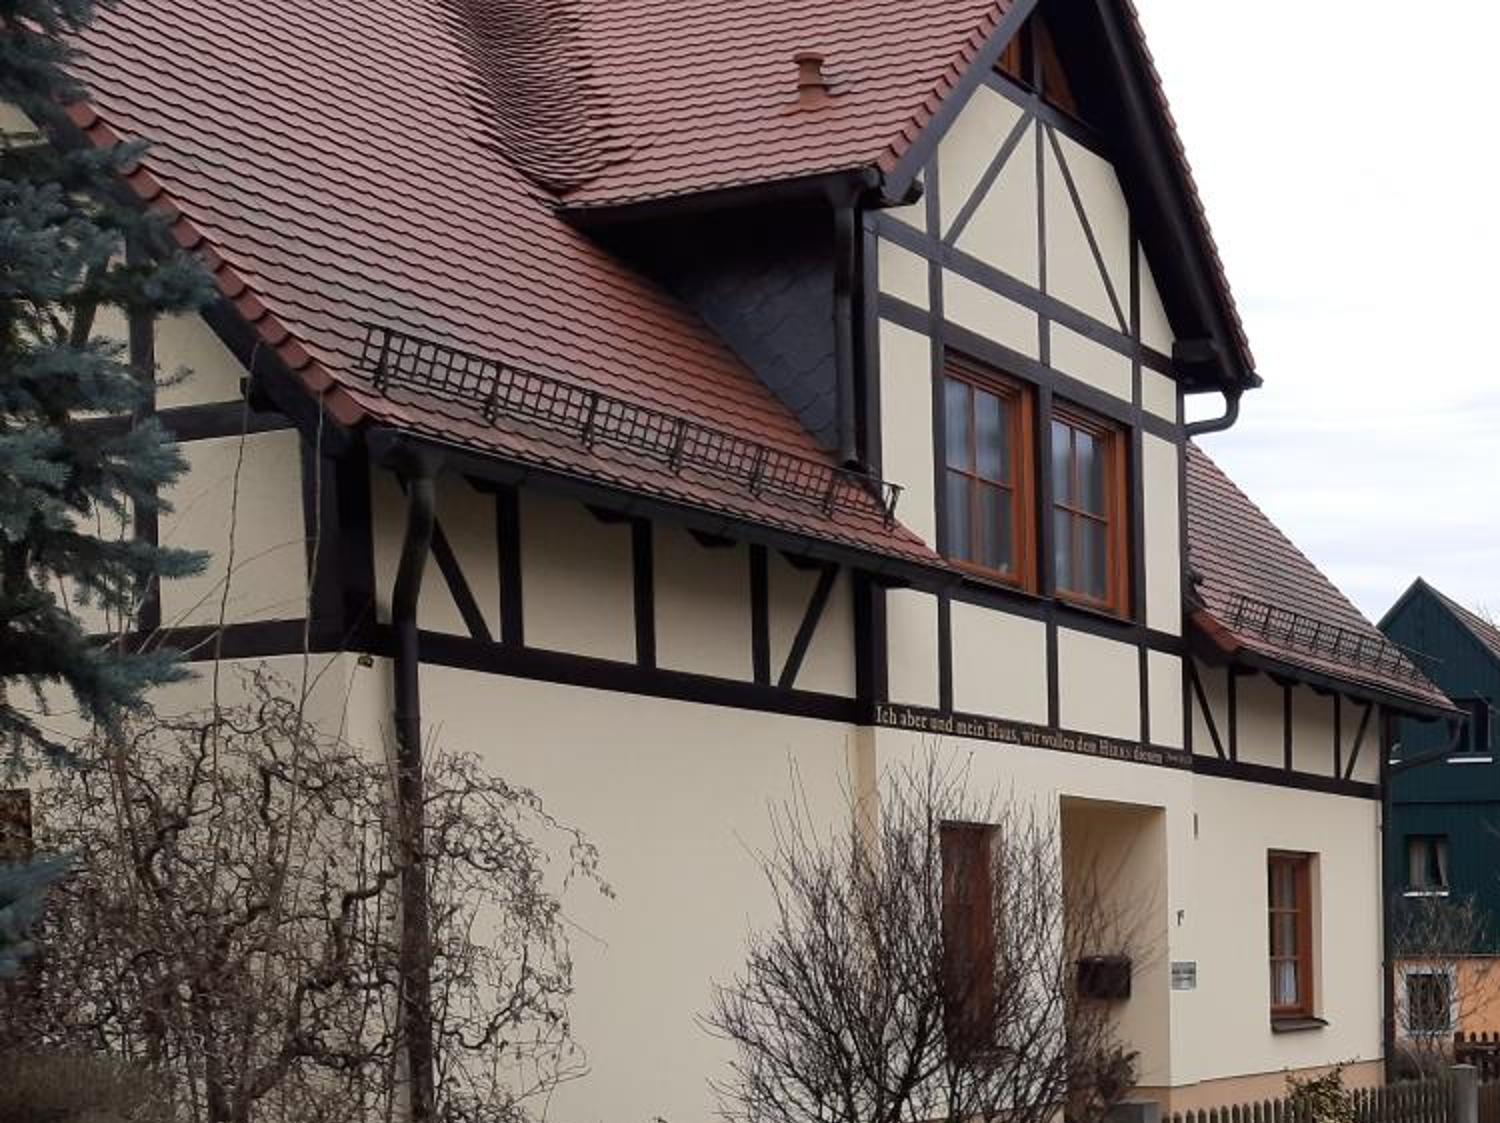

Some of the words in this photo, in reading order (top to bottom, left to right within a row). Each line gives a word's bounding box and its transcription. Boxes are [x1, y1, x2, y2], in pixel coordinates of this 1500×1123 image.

[876, 705, 897, 725] Ich
[899, 708, 928, 729] aber
[930, 715, 953, 733] und
[956, 719, 985, 736] mein
[1022, 728, 1042, 743] wir
[1042, 731, 1075, 749] wollen
